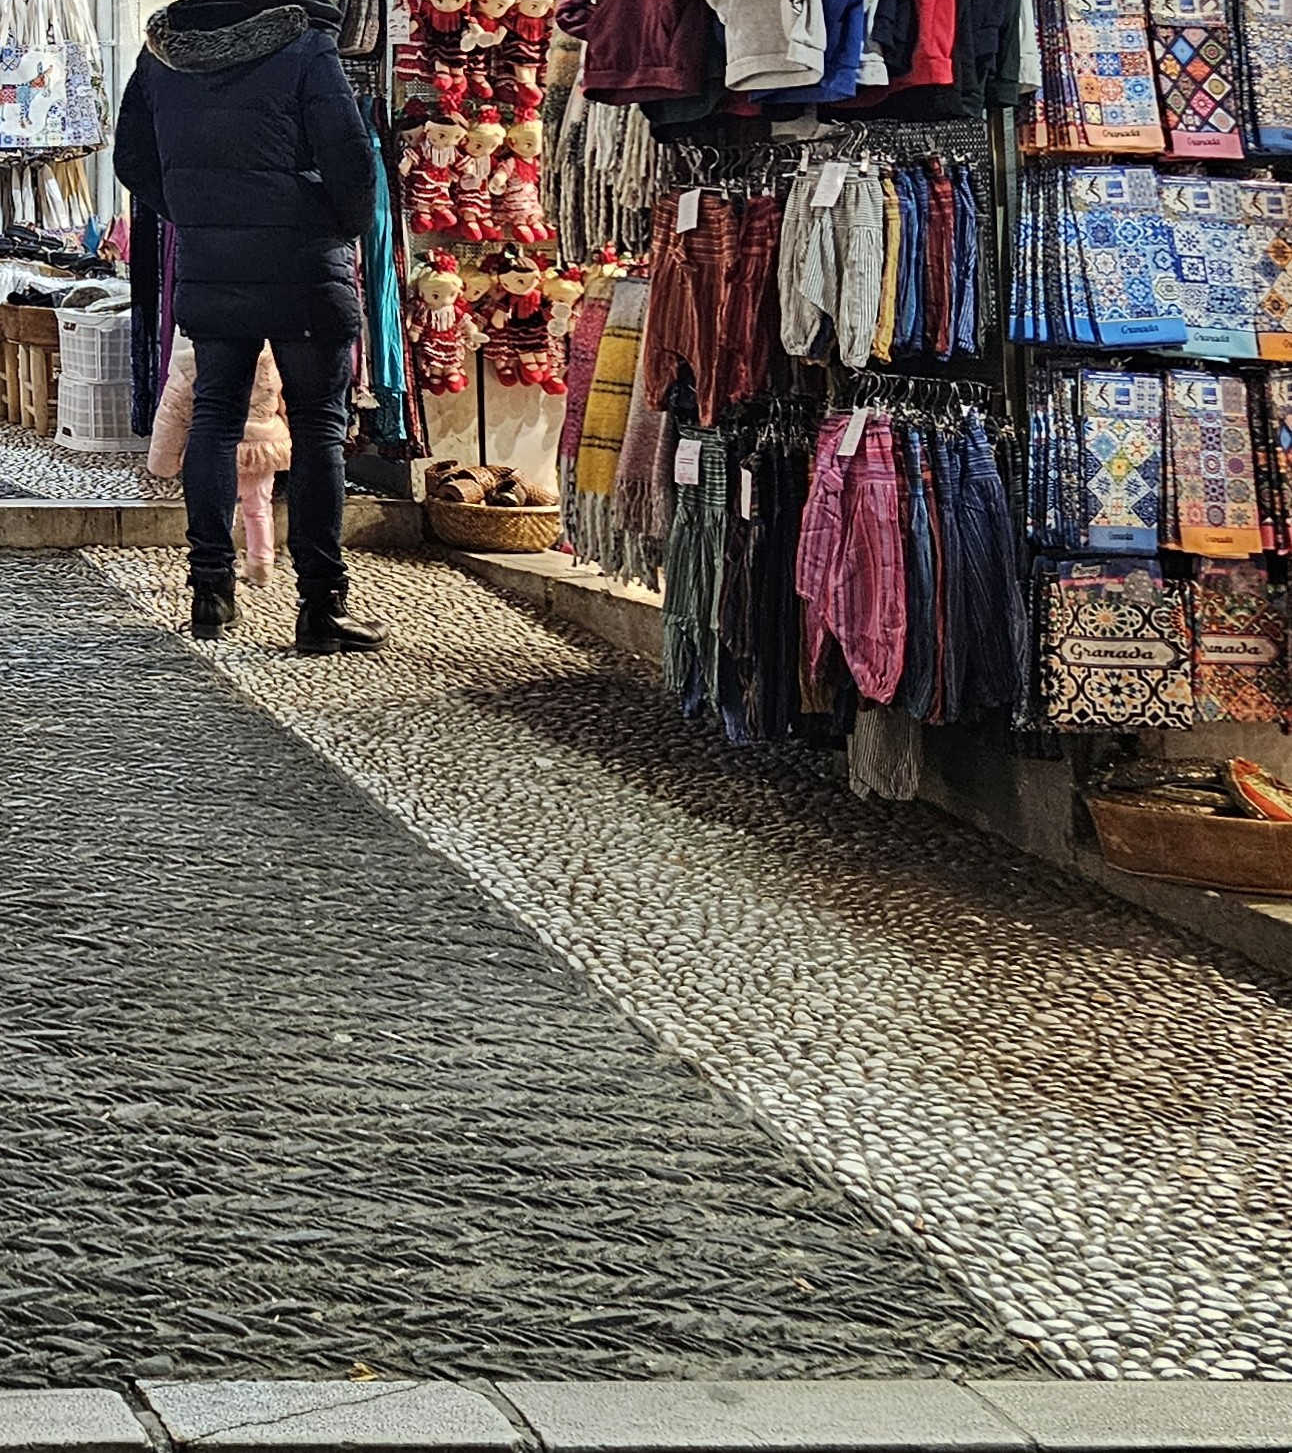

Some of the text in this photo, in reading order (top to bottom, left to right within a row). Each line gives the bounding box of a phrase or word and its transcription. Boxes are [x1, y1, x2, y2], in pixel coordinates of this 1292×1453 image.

[1103, 129, 1141, 138] Granada
[1121, 324, 1159, 334] Granada
[1193, 331, 1230, 343] Granada
[1069, 642, 1156, 660] Granada
